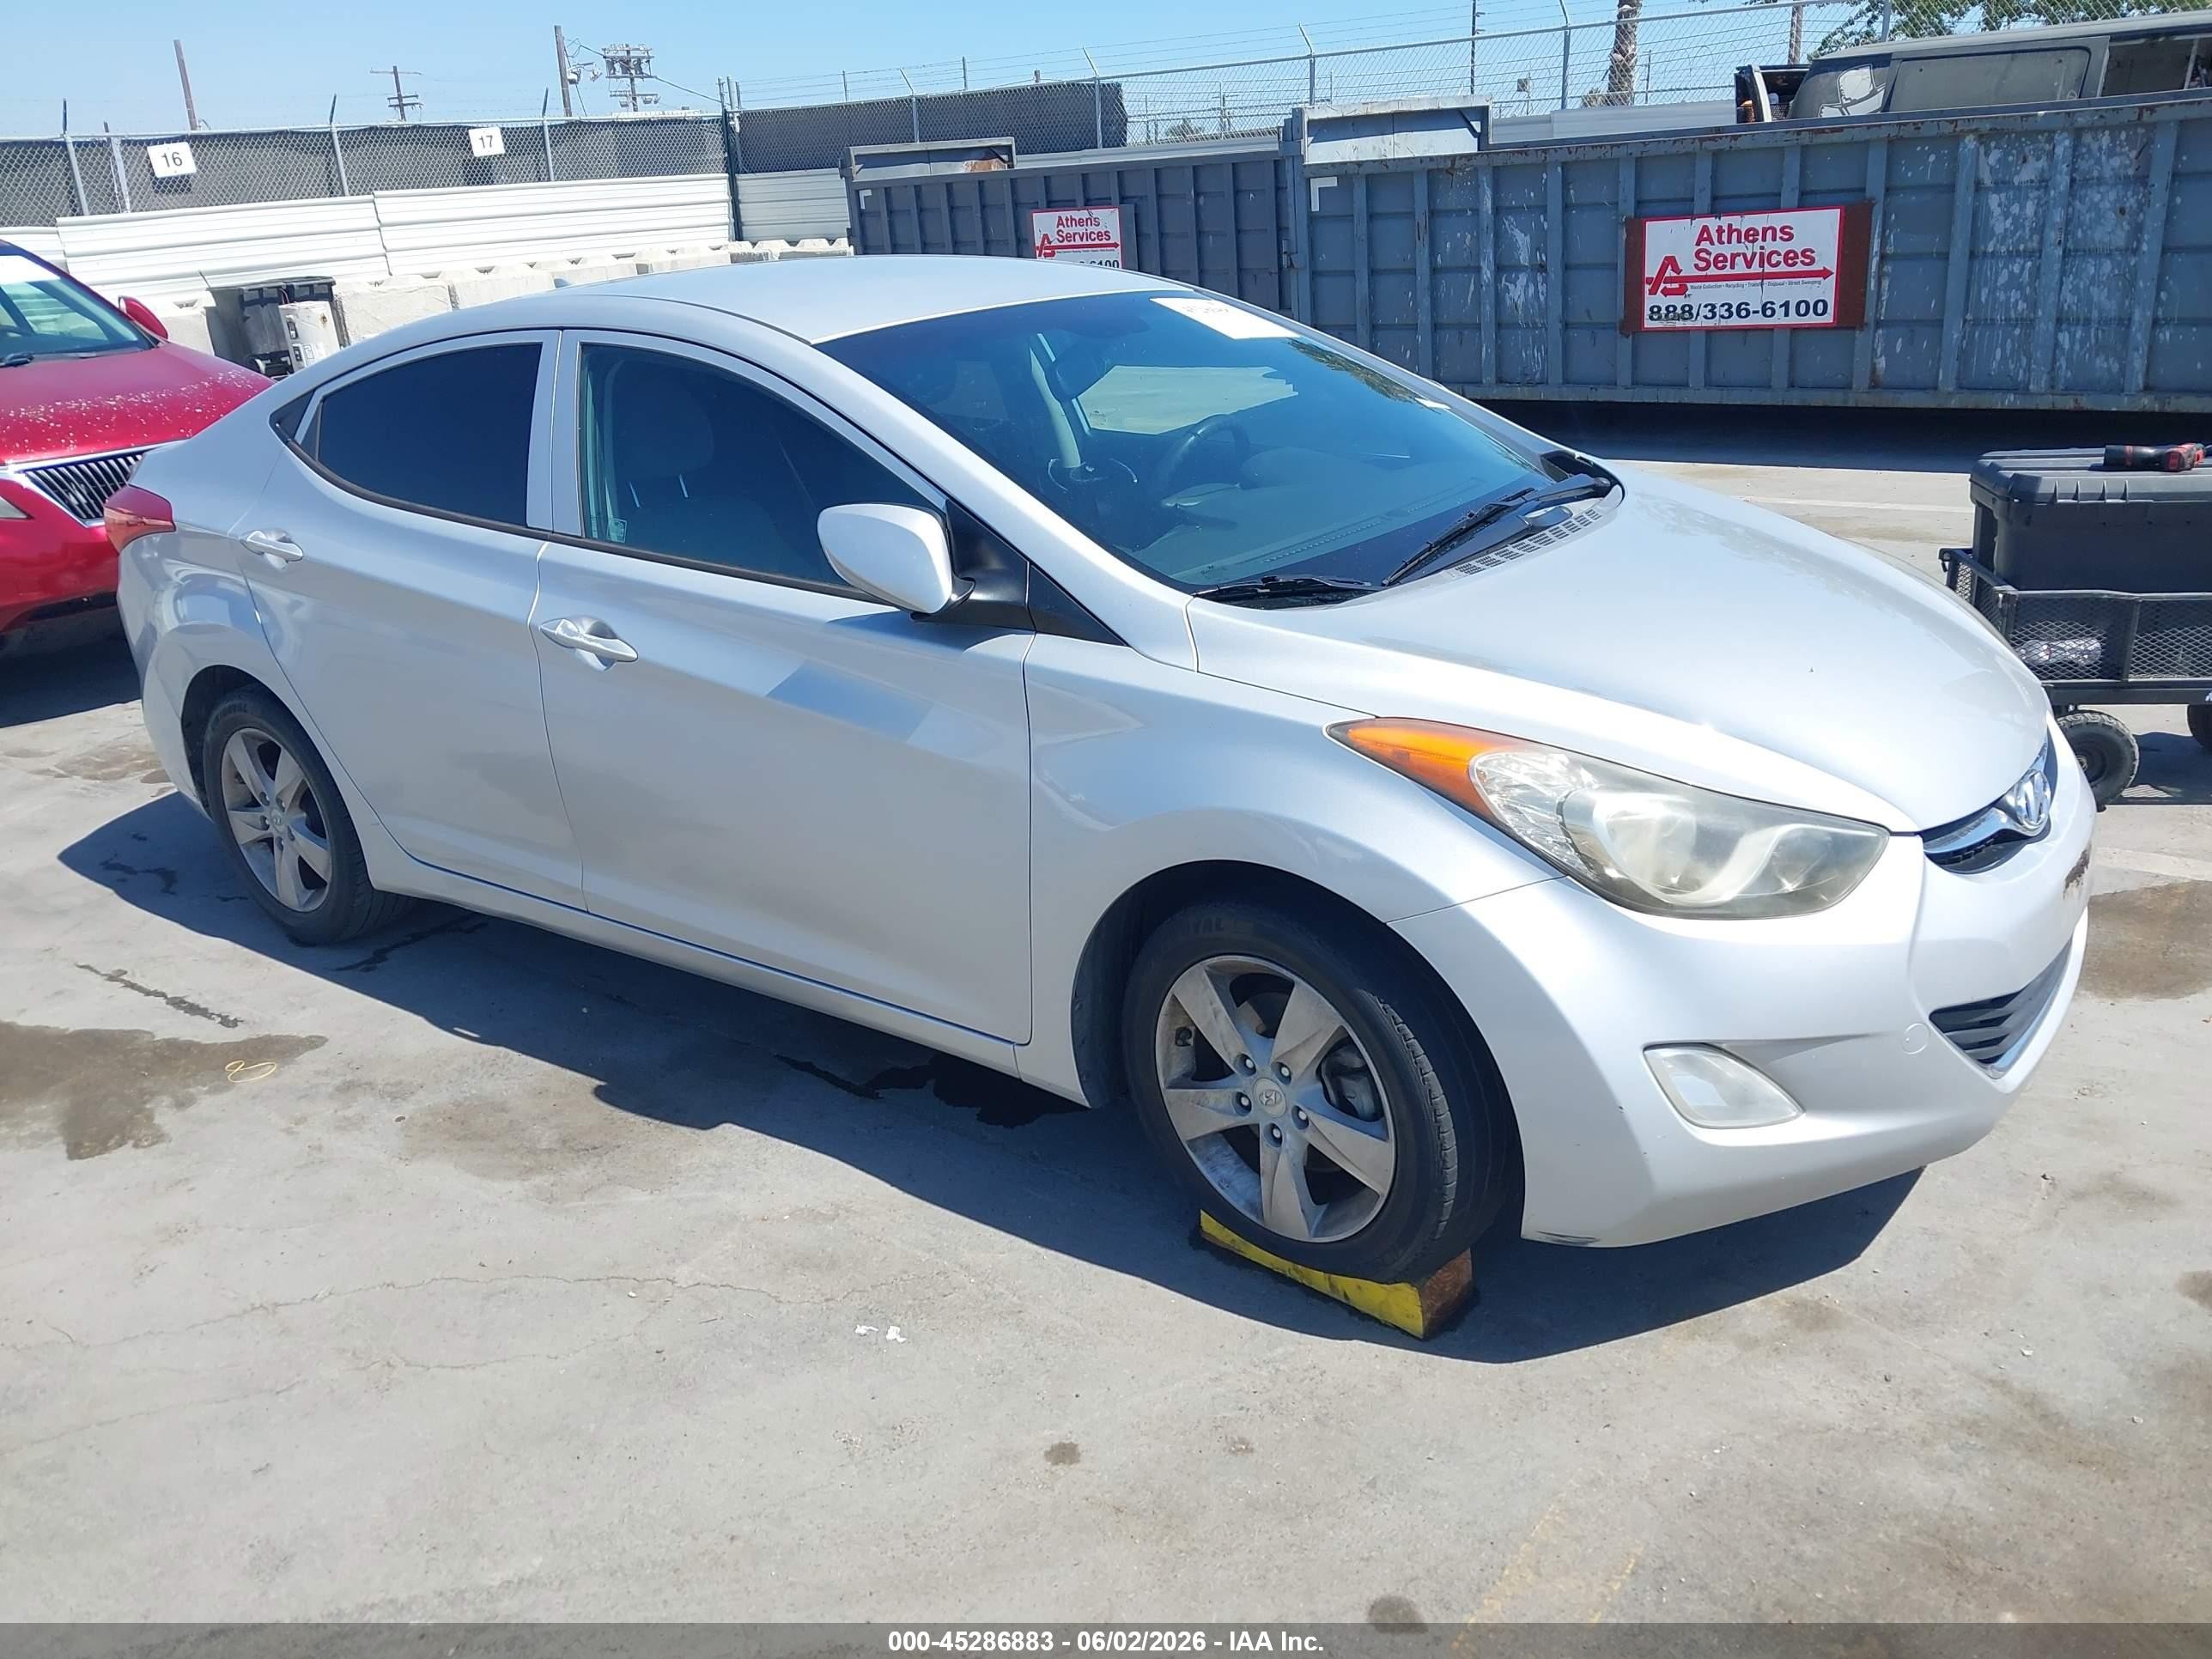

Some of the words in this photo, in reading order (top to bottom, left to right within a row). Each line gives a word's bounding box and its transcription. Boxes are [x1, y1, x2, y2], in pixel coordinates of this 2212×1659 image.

[478, 135, 494, 149] 17
[161, 151, 183, 167] 16
[1056, 215, 1101, 228] Athens
[1056, 228, 1111, 243] Services
[1695, 223, 1795, 246] Athens
[1693, 246, 1816, 271] Services
[1648, 299, 1829, 322] 888/336-6100
